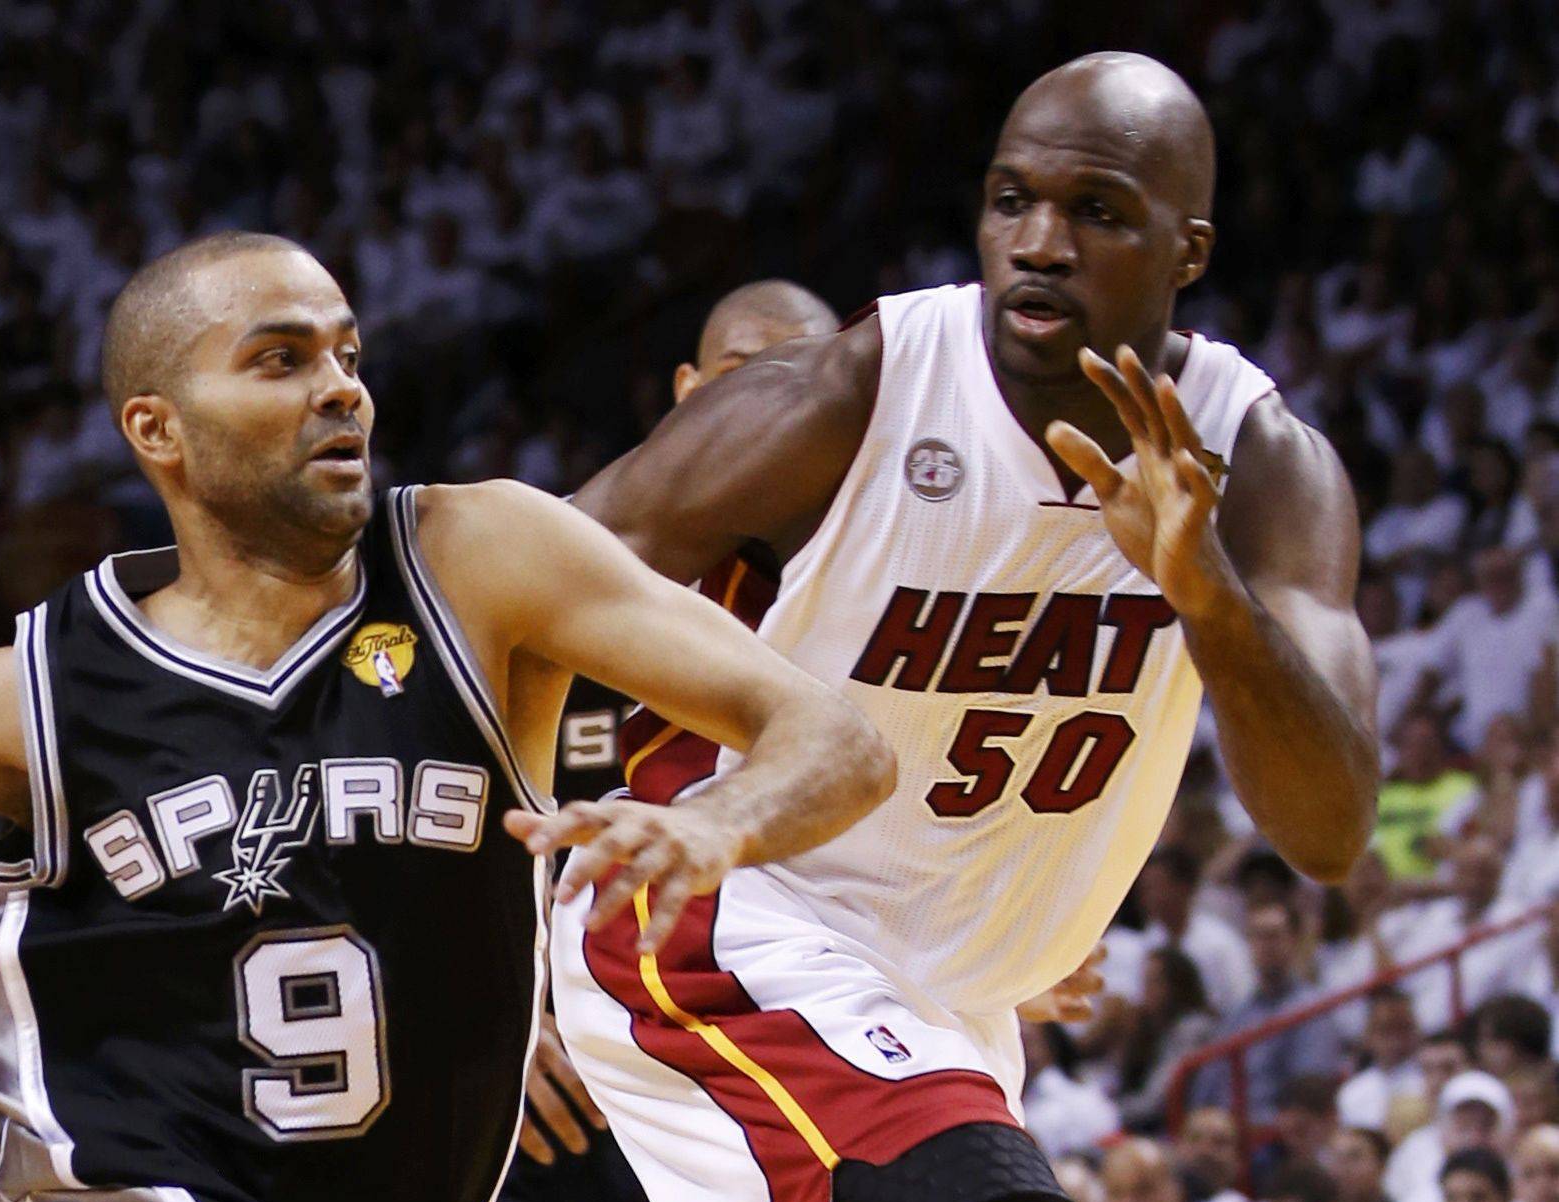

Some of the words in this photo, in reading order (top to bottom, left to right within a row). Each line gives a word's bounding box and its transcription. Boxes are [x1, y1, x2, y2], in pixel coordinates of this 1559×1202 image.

[848, 584, 1181, 698] HEAT
[924, 708, 1138, 818] 50
[82, 756, 491, 914] SPURS
[232, 923, 392, 1143] 9
